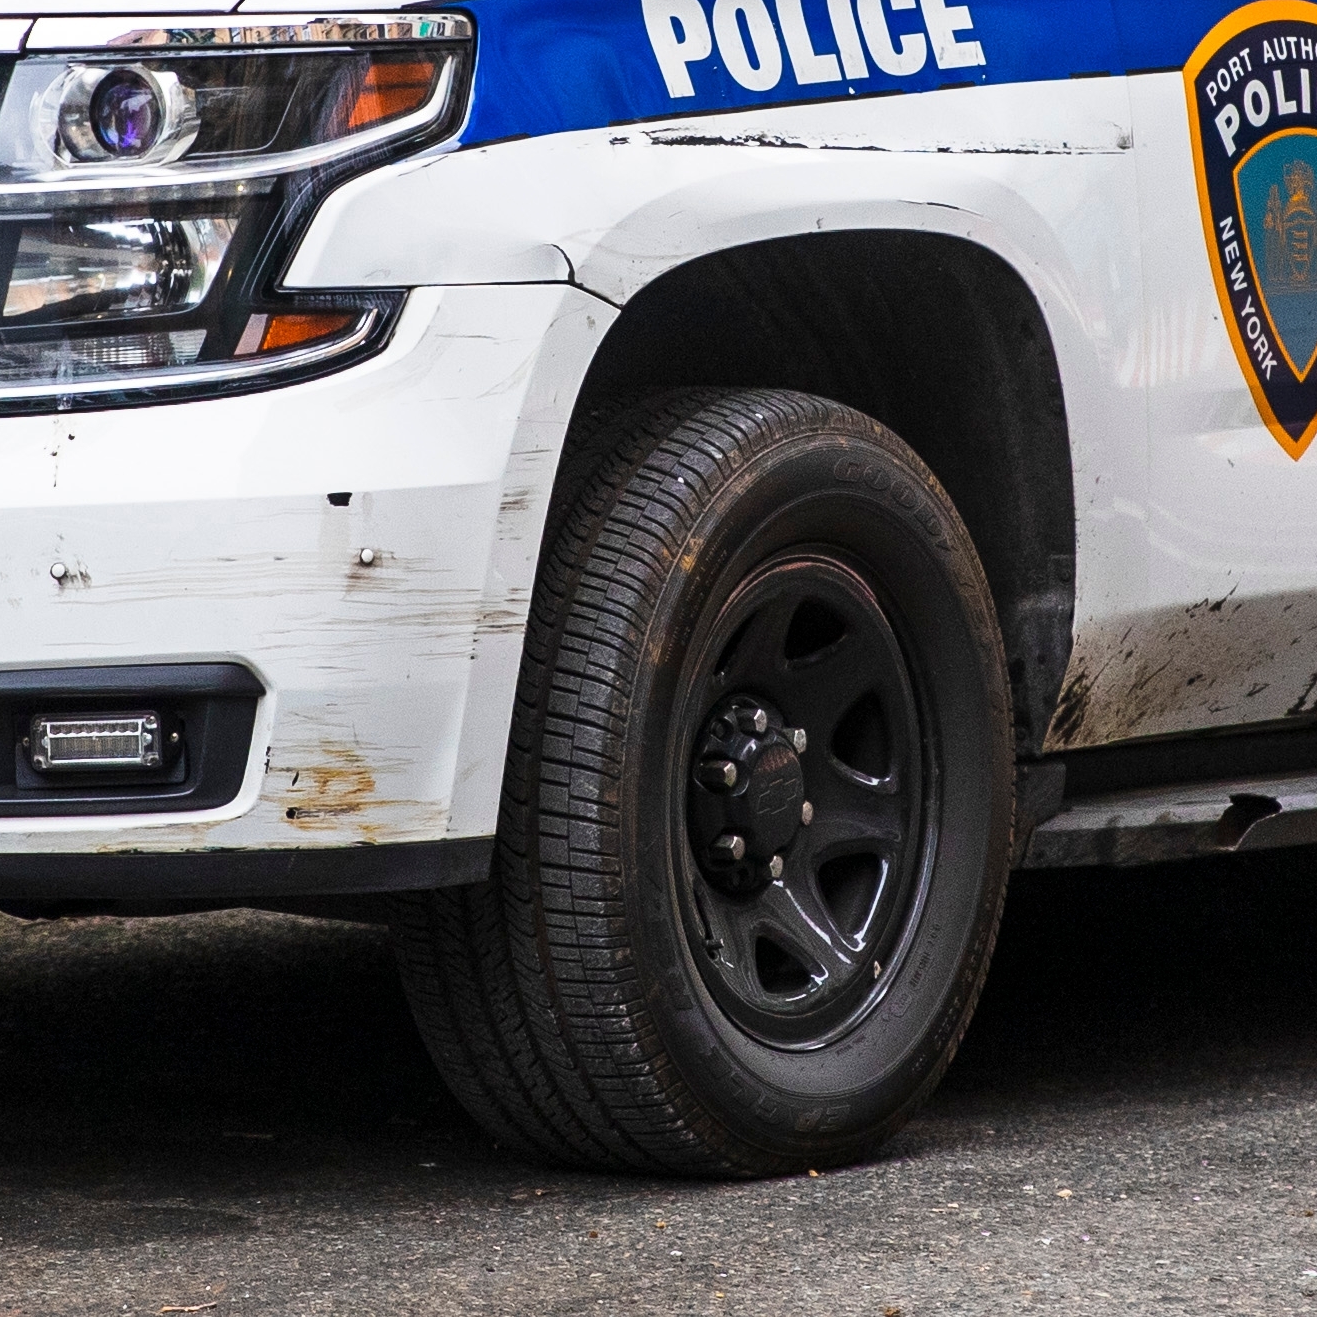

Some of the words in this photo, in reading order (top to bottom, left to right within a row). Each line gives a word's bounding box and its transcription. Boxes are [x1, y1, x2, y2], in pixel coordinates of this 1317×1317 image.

[1205, 47, 1254, 107] PORT
[1219, 215, 1249, 293] NEW
[1240, 296, 1277, 383] YORK
